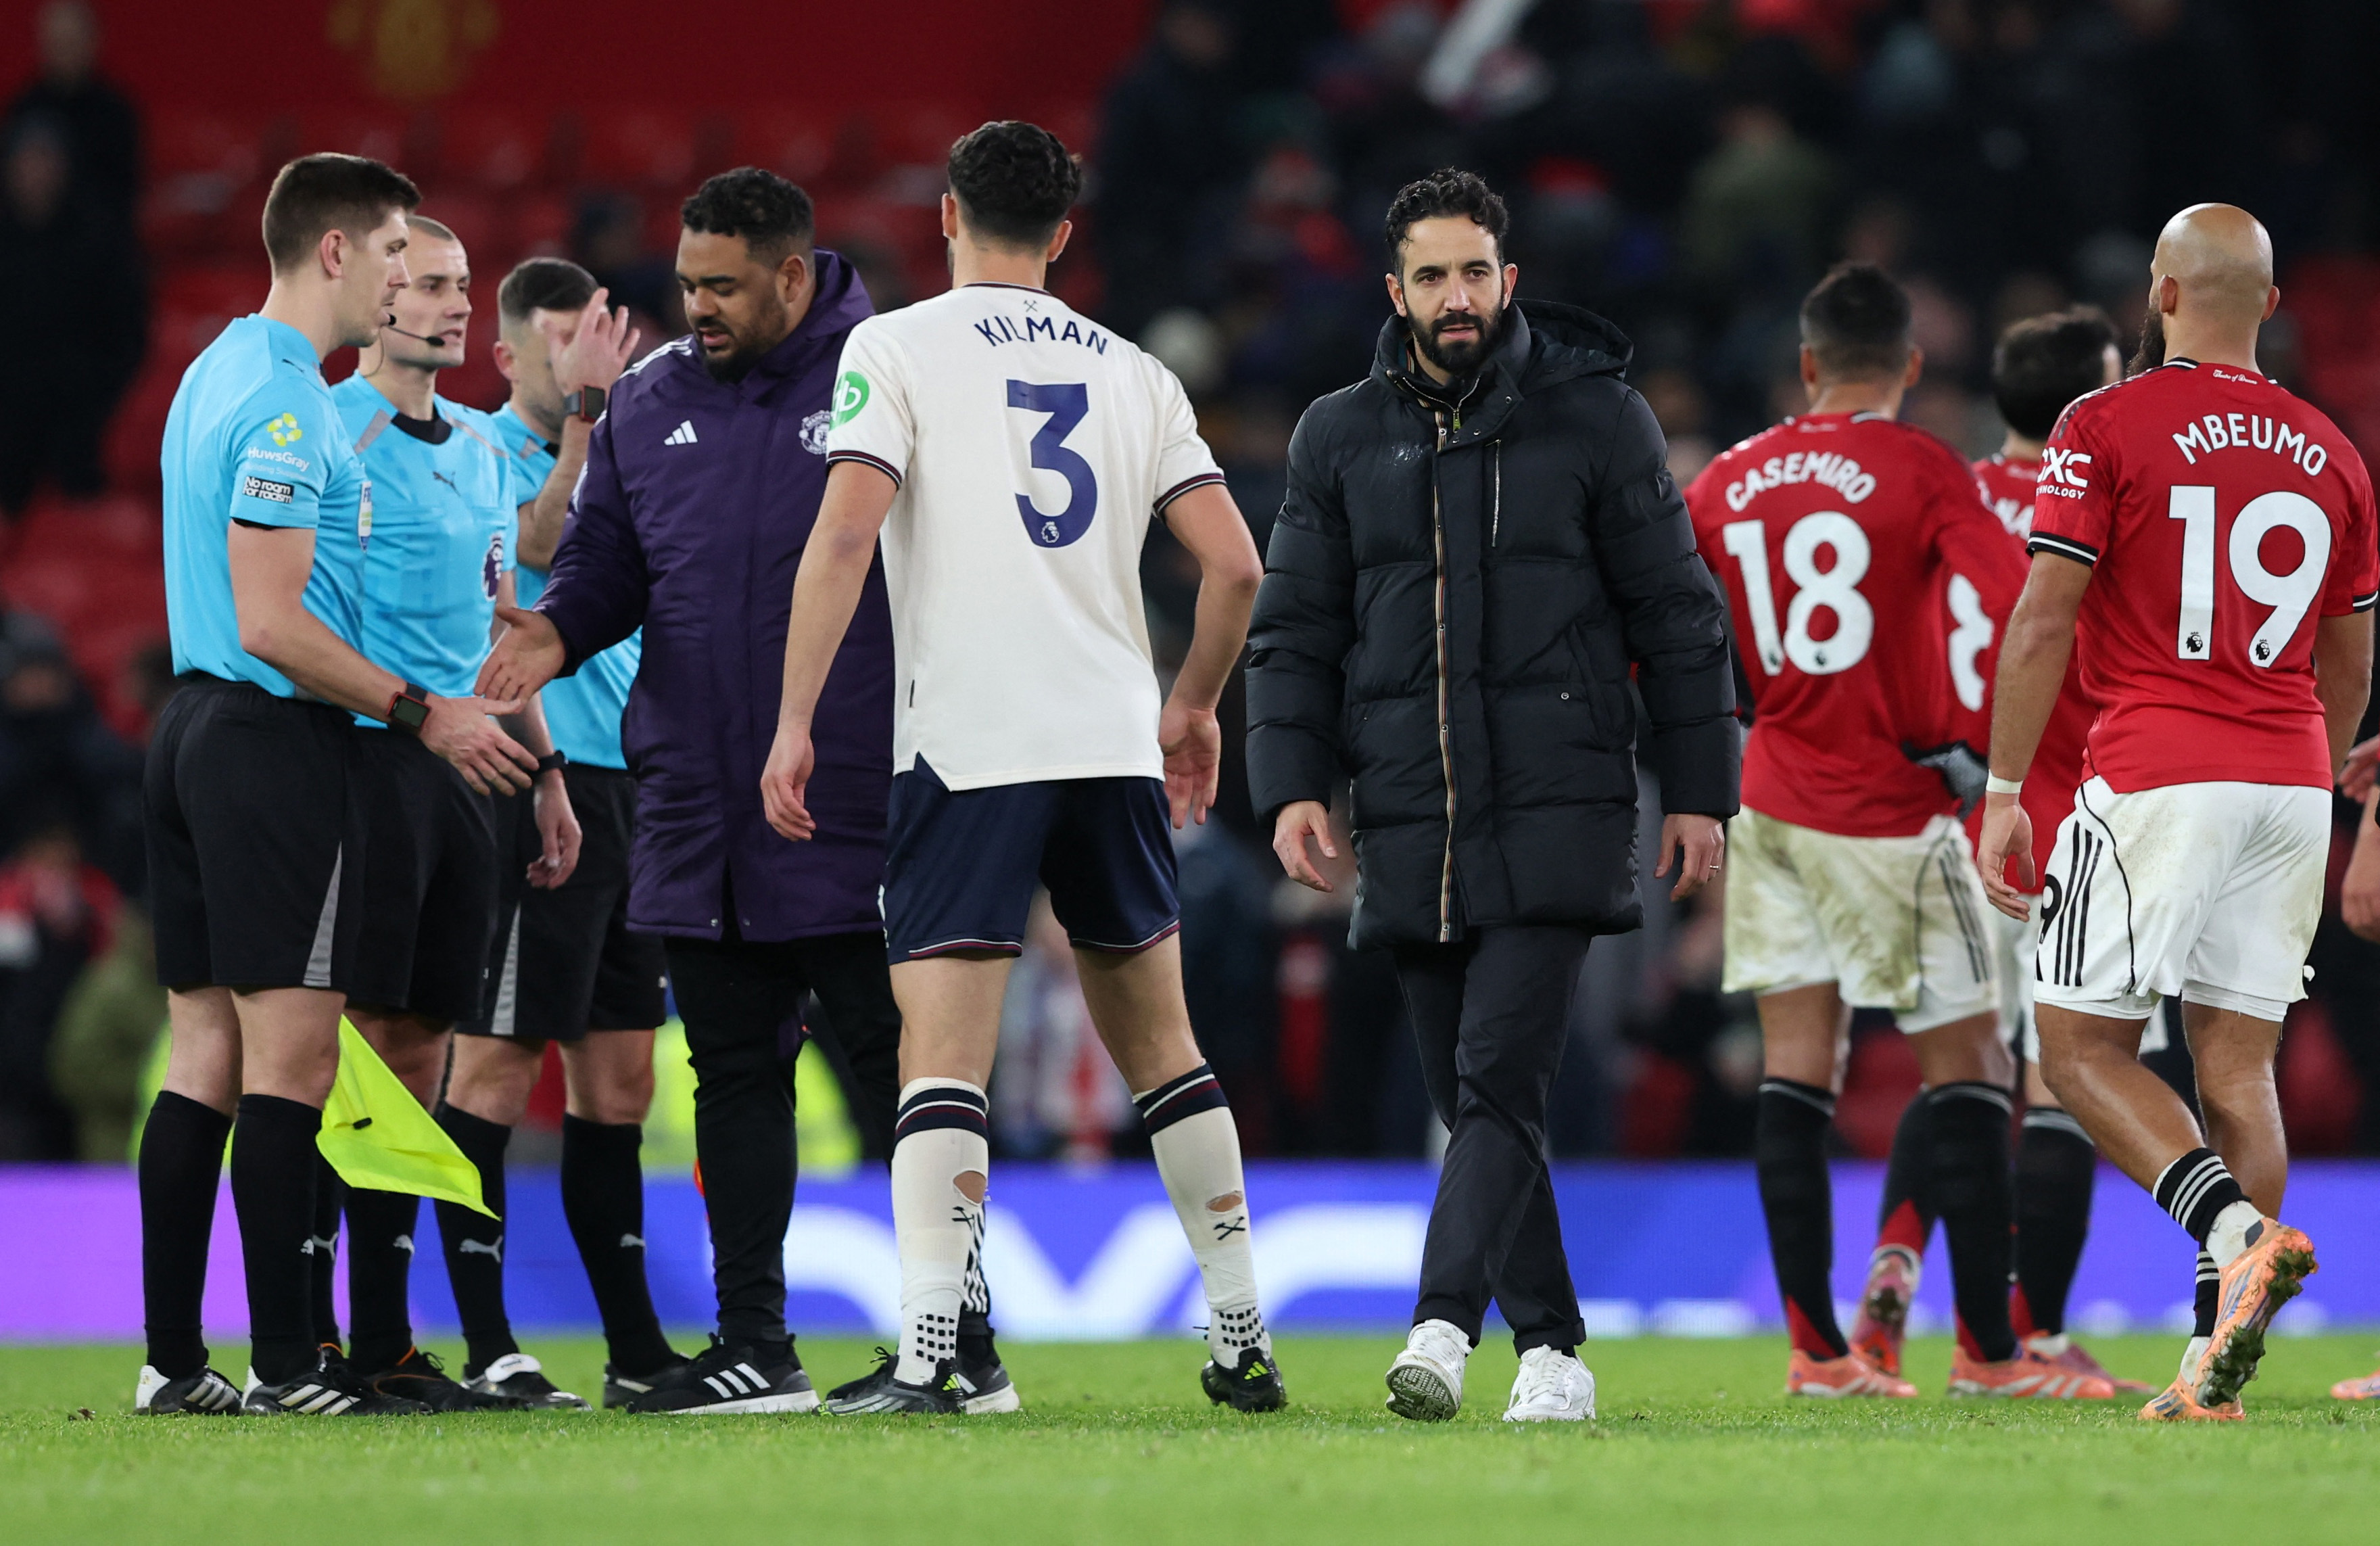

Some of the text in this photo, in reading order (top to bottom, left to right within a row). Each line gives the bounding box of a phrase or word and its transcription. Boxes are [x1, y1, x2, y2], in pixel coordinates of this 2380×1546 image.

[974, 316, 1108, 356] KILMAN
[247, 447, 310, 472] HuwsGray
[1006, 379, 1098, 548] 3
[2172, 413, 2327, 477] MBEUMO
[245, 476, 291, 496] No room
[258, 490, 292, 505] racism
[1726, 451, 1876, 512] CASEMIRO
[1723, 511, 1875, 676] 18
[2168, 485, 2331, 668] 19
